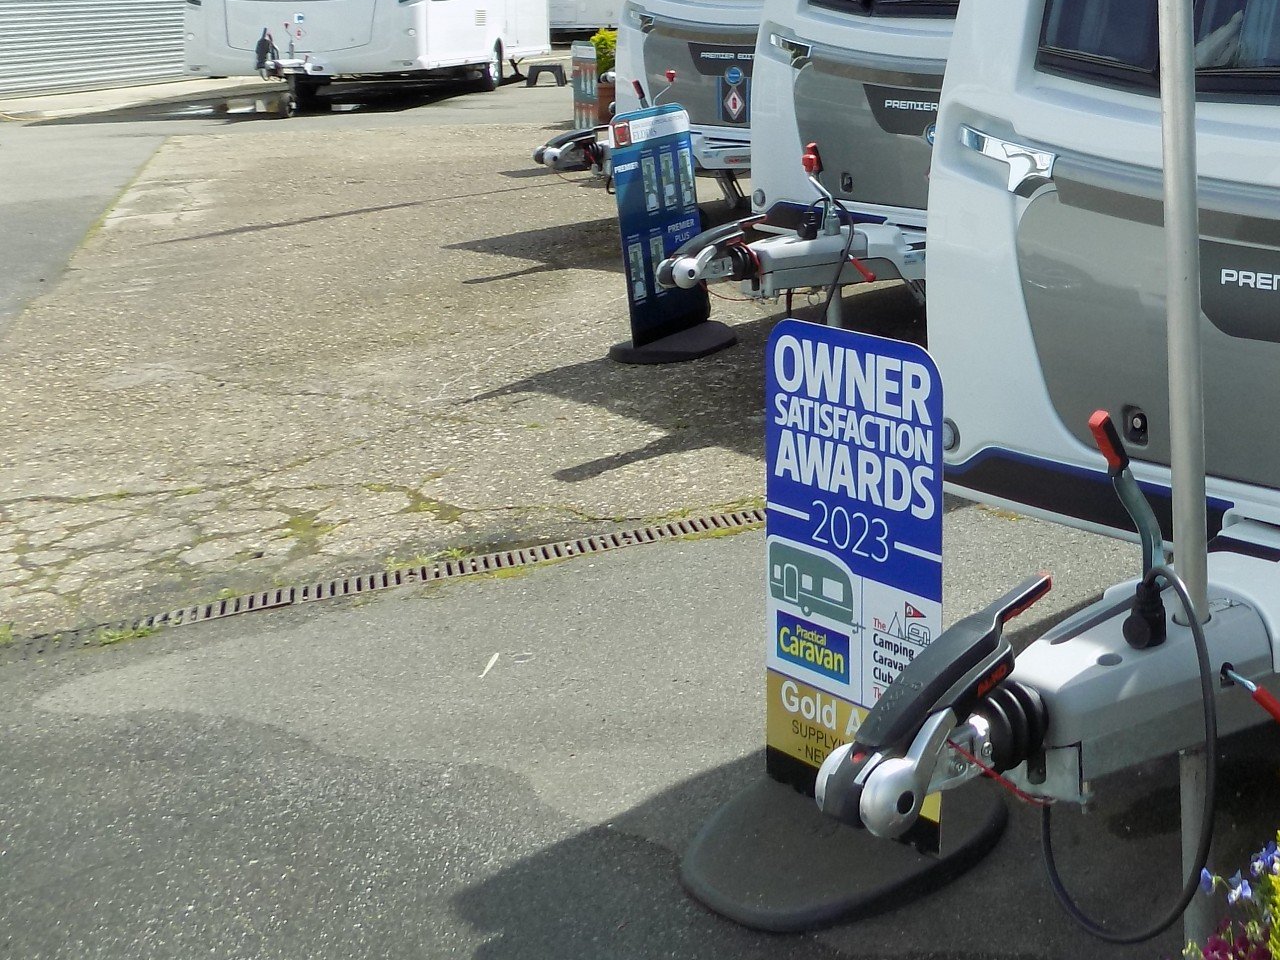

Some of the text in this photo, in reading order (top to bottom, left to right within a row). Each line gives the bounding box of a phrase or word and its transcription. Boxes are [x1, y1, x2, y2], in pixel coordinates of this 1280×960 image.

[884, 99, 939, 111] PREMIER
[614, 161, 640, 174] PREMIER
[667, 218, 695, 233] PREMIER
[674, 231, 690, 243] PLUS
[774, 334, 932, 427] OWNER
[774, 392, 933, 465] SATISFACTION
[774, 429, 935, 521] AWARDS
[811, 499, 889, 564] 2023
[796, 624, 827, 646] Practical
[873, 617, 887, 631] The
[780, 626, 845, 675] Caravan
[873, 633, 915, 662] Camping
[873, 666, 893, 685] Club
[781, 680, 837, 731] Gold
